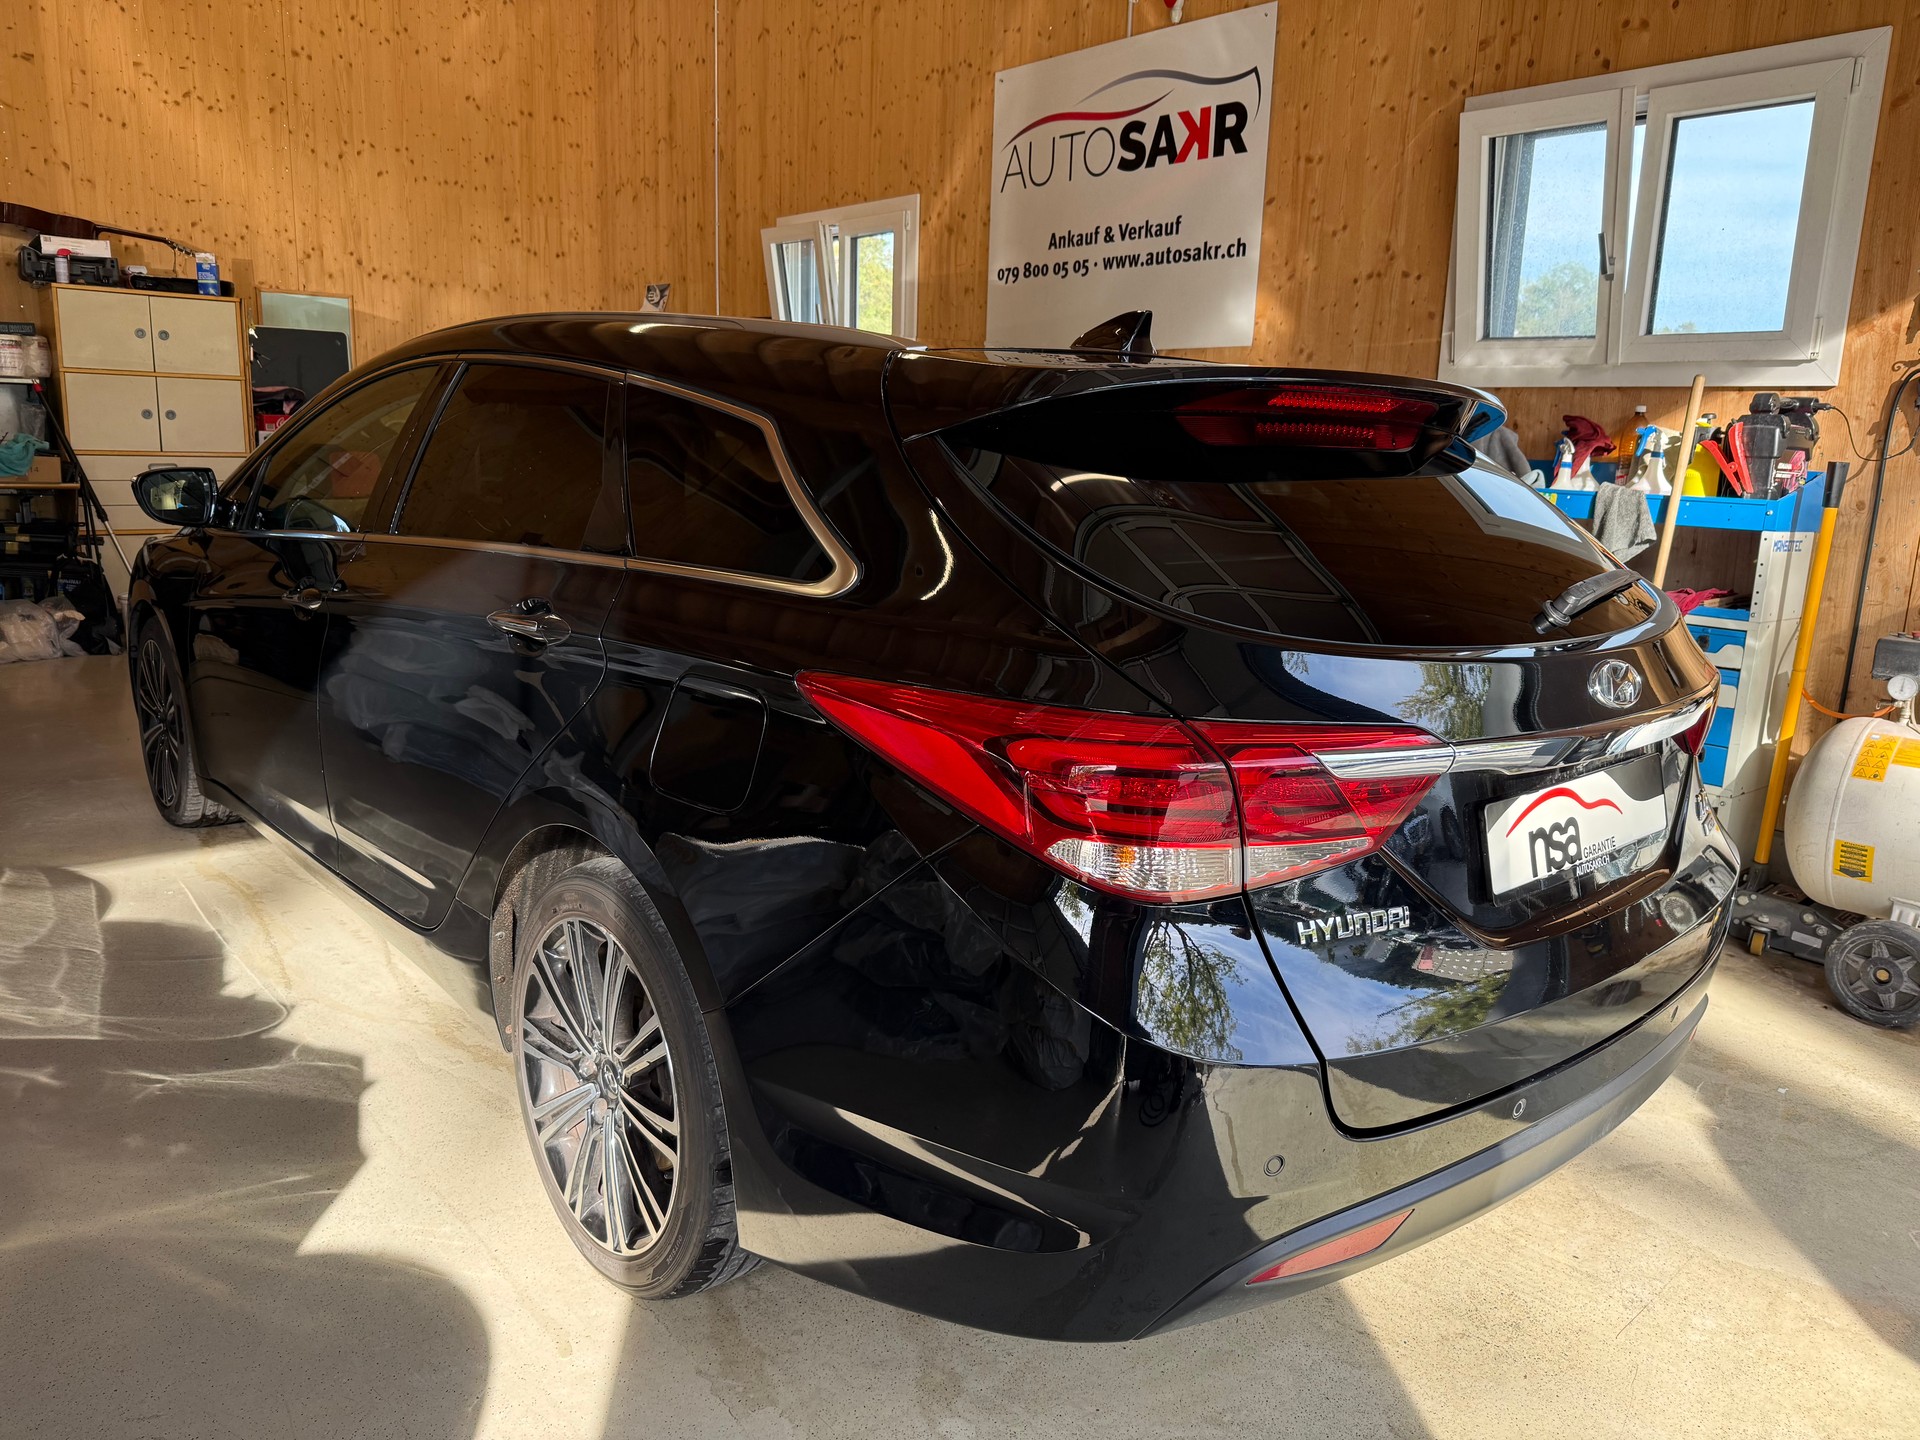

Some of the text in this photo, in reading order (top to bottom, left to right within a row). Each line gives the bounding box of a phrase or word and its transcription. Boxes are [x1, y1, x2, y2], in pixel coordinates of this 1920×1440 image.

[1000, 101, 1248, 193] AUTOSAKR
[1048, 215, 1182, 250] Ankauf & Verkauf
[997, 266, 1020, 285] 079
[1023, 261, 1049, 279] 800
[1052, 261, 1069, 279] 05
[1072, 258, 1089, 276] 05
[1103, 237, 1247, 271] www.autosakr.ch
[1528, 817, 1582, 878] nsa
[1583, 836, 1617, 859] GARANTIE
[1297, 905, 1410, 945] HYUNDAI
